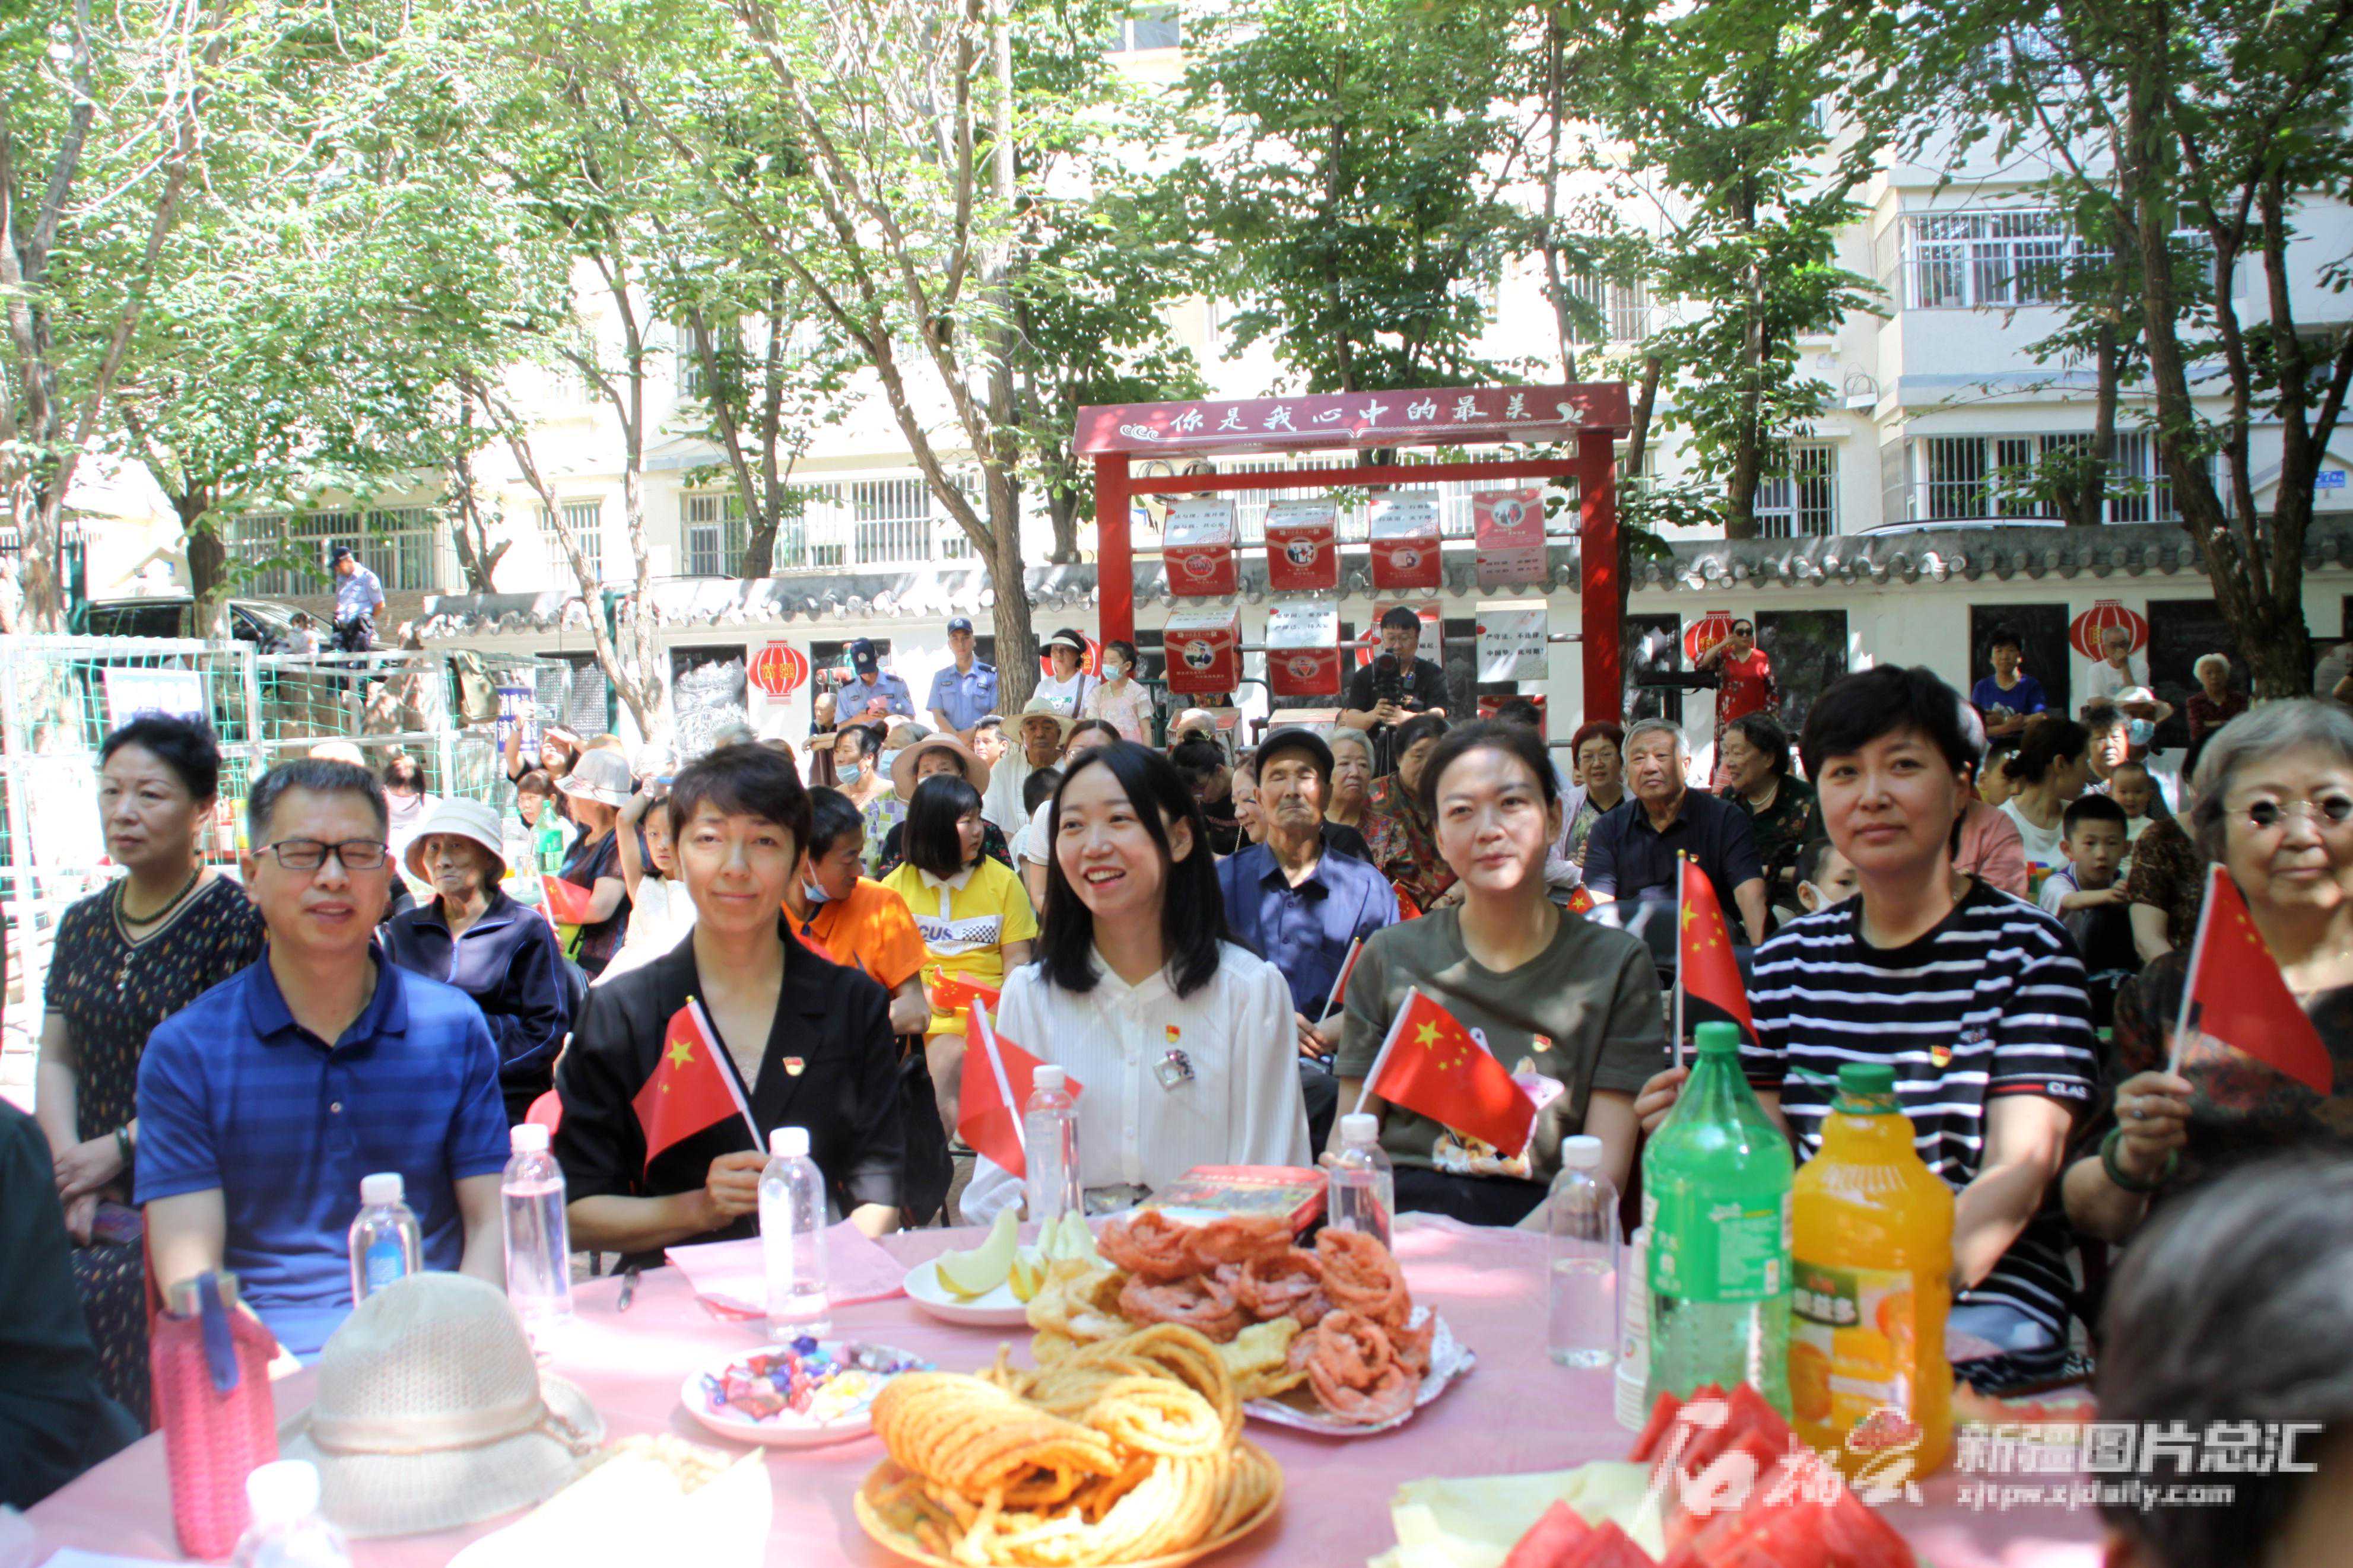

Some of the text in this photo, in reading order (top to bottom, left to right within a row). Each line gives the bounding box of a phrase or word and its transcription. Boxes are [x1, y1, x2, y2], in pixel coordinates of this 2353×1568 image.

[1170, 393, 1532, 432] 你是我心中的最美
